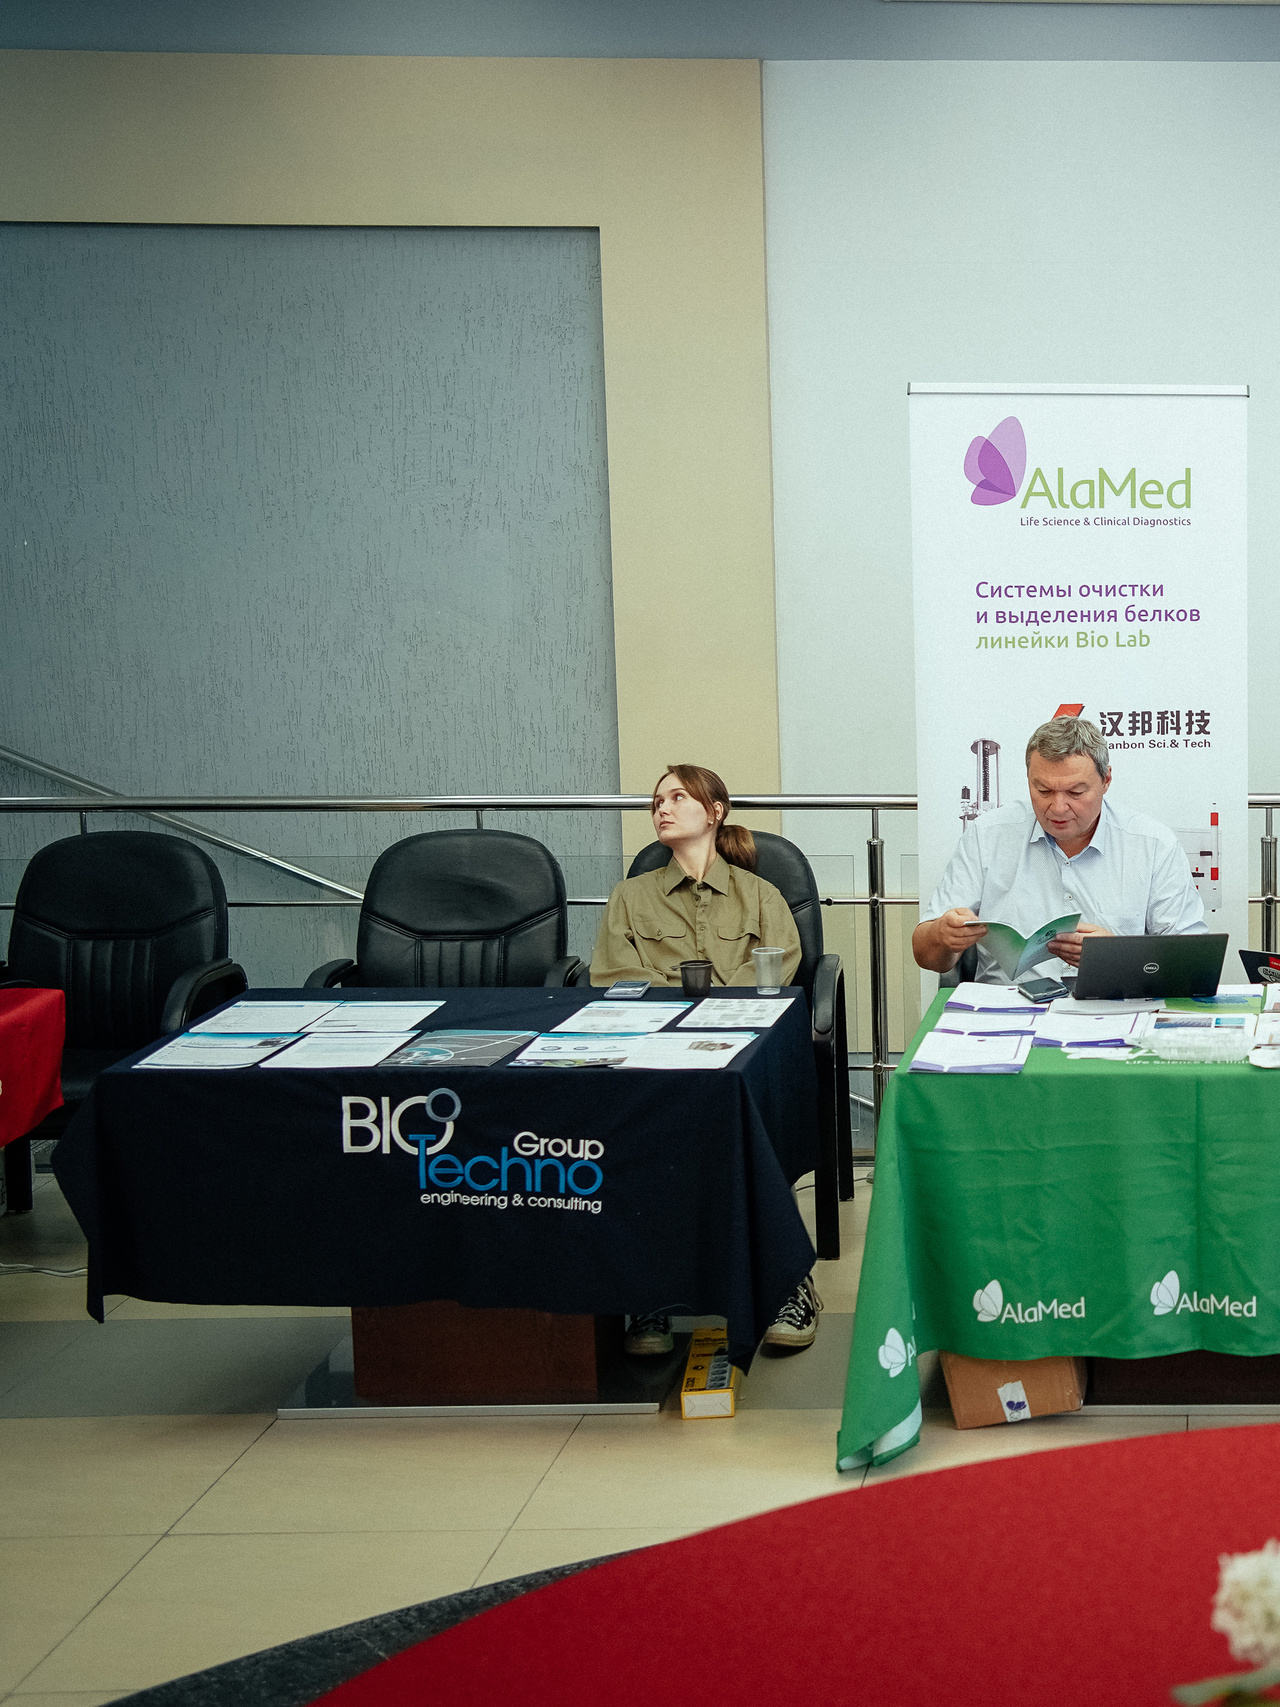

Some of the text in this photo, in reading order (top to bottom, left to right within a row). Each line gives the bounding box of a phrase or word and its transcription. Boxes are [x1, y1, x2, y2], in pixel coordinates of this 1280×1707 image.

[1020, 467, 1191, 509] AlaMed
[1020, 517, 1191, 528] Life Science & Clinical Diagnostics
[975, 581, 1164, 598] Системы очистки
[976, 605, 1201, 627] и выделения белков
[975, 629, 1150, 650] линейки Bio Lab
[1099, 710, 1211, 737] 汉邦科技
[1105, 739, 1145, 750] anbon
[1183, 738, 1211, 749] Tech
[513, 1131, 605, 1161] Group
[408, 1134, 604, 1195] Techno
[420, 1191, 602, 1214] engineering & consulting
[1001, 1296, 1086, 1325] AlaMed
[1176, 1291, 1257, 1319] AlaMed
